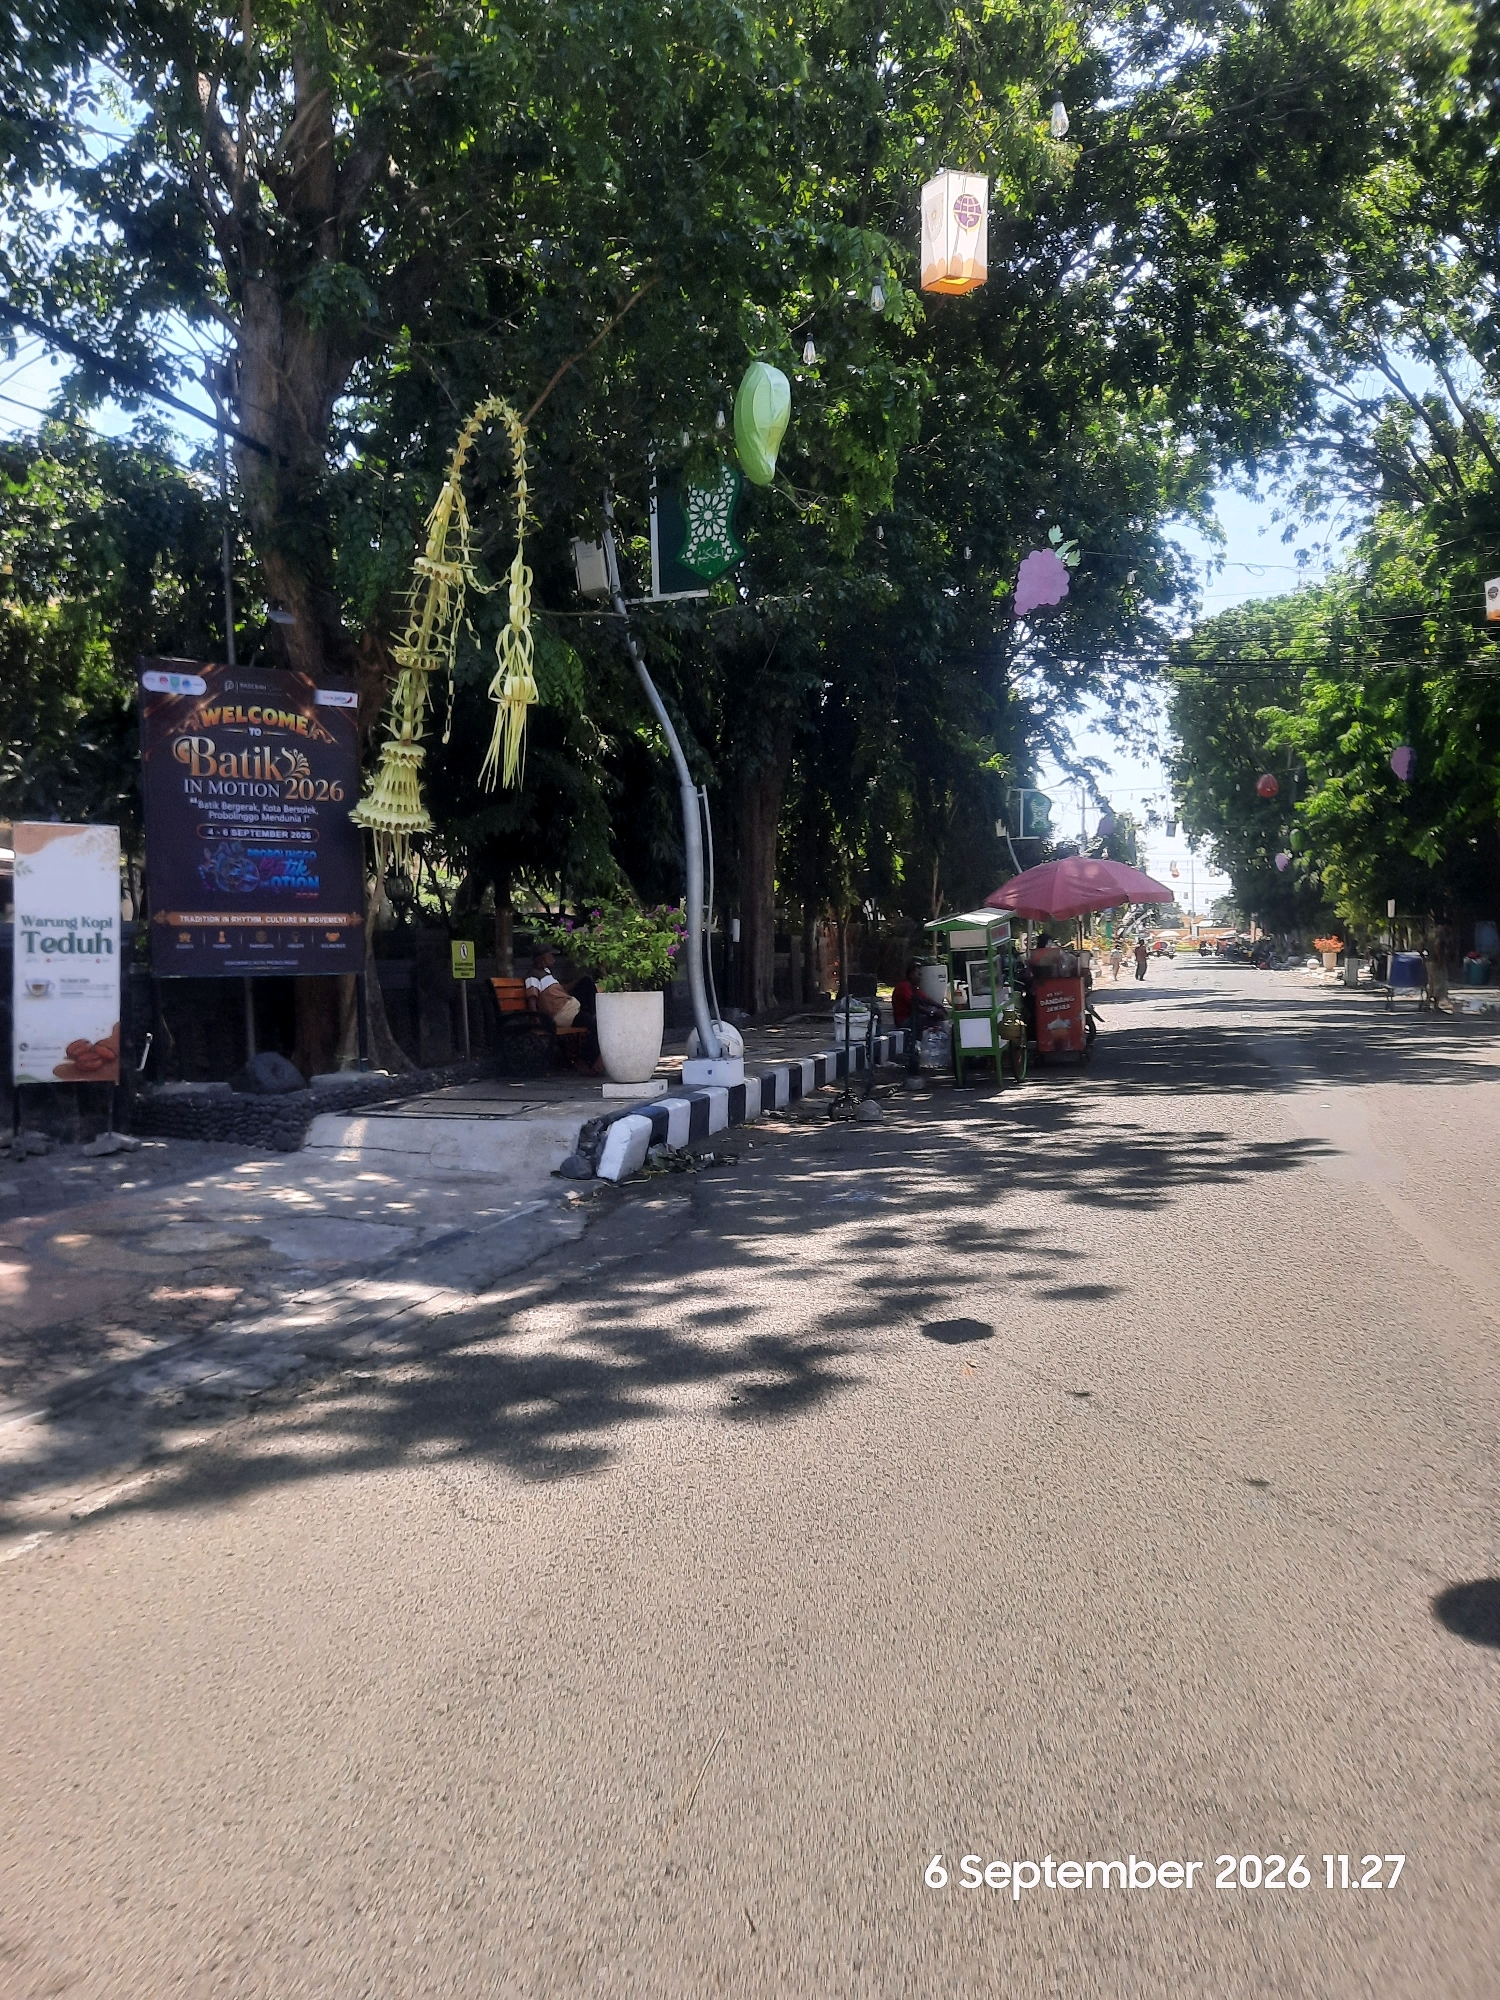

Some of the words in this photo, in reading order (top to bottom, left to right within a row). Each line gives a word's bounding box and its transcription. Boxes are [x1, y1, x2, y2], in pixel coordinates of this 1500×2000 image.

[200, 705, 310, 736] WELCOME
[249, 728, 262, 737] TO
[173, 736, 285, 781] Batik
[184, 778, 203, 794] IN
[208, 781, 281, 798] MOTION
[284, 778, 345, 802] 2026
[262, 803, 281, 813] Kota
[208, 810, 260, 823] Probolinggo
[261, 812, 302, 823] Mendunia
[208, 828, 214, 836] 4
[231, 829, 289, 839] SEPTEMBER
[290, 831, 312, 840] 2026
[21, 914, 78, 931] Warung
[81, 916, 113, 931] Kopi
[179, 915, 221, 923] TRADITION
[265, 916, 297, 924] CULTURE
[20, 930, 114, 955] Teduh
